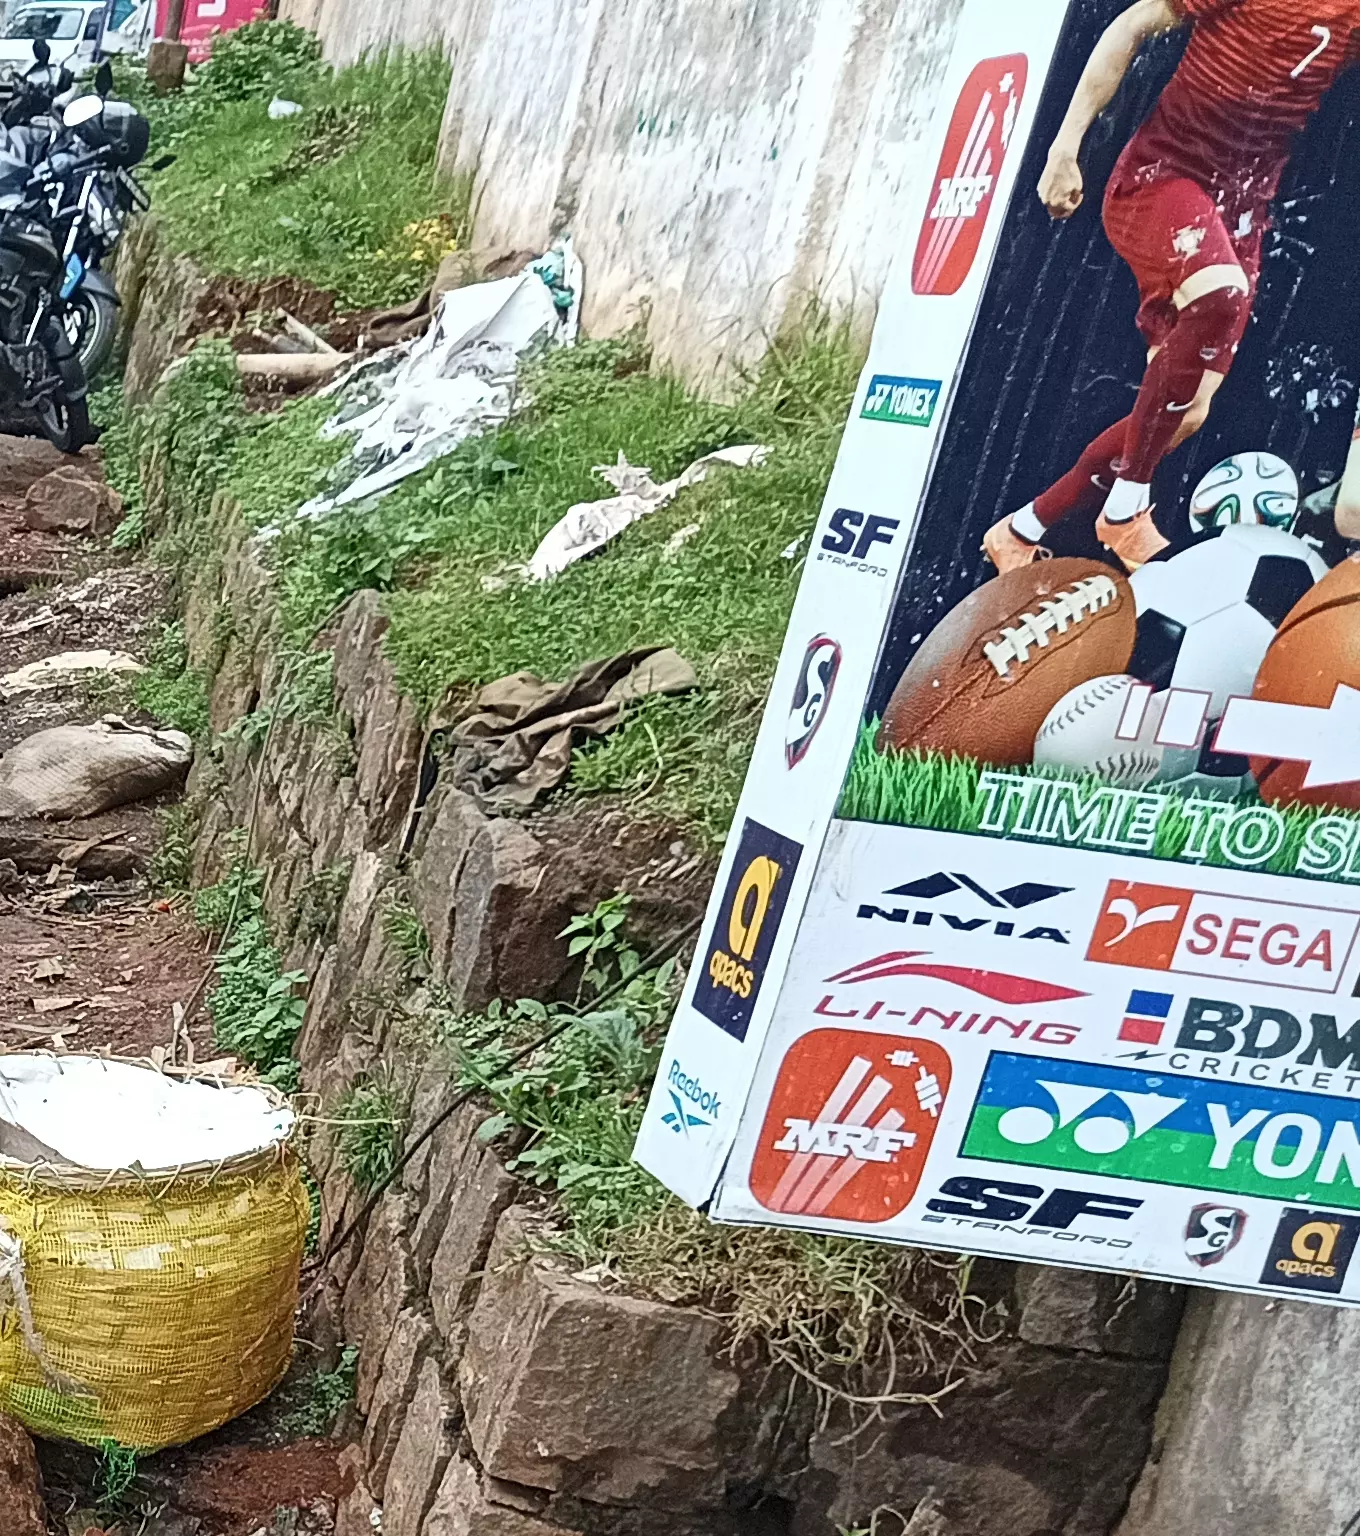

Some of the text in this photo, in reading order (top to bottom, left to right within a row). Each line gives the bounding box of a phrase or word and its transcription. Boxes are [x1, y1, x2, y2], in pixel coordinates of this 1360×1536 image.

[1290, 24, 1331, 78] 7
[930, 174, 993, 218] MRF
[887, 384, 935, 418] YONEX
[821, 508, 901, 560] SF
[816, 552, 888, 578] STANFORD
[978, 770, 1168, 852] TIME
[1180, 798, 1286, 866] TO
[856, 903, 1071, 945] NIVIA
[1185, 912, 1333, 972] SEGA
[708, 949, 755, 999] apacs
[813, 994, 1083, 1046] LI-NING
[1174, 996, 1360, 1072] BDM
[667, 1059, 722, 1120] Reebok
[1168, 1052, 1360, 1093] CRICKET
[773, 1117, 917, 1163] MRF
[1206, 1102, 1360, 1189] YON
[925, 1175, 1146, 1230] SF
[920, 1213, 1134, 1250] STANFORD
[1275, 1258, 1337, 1279] apacs
